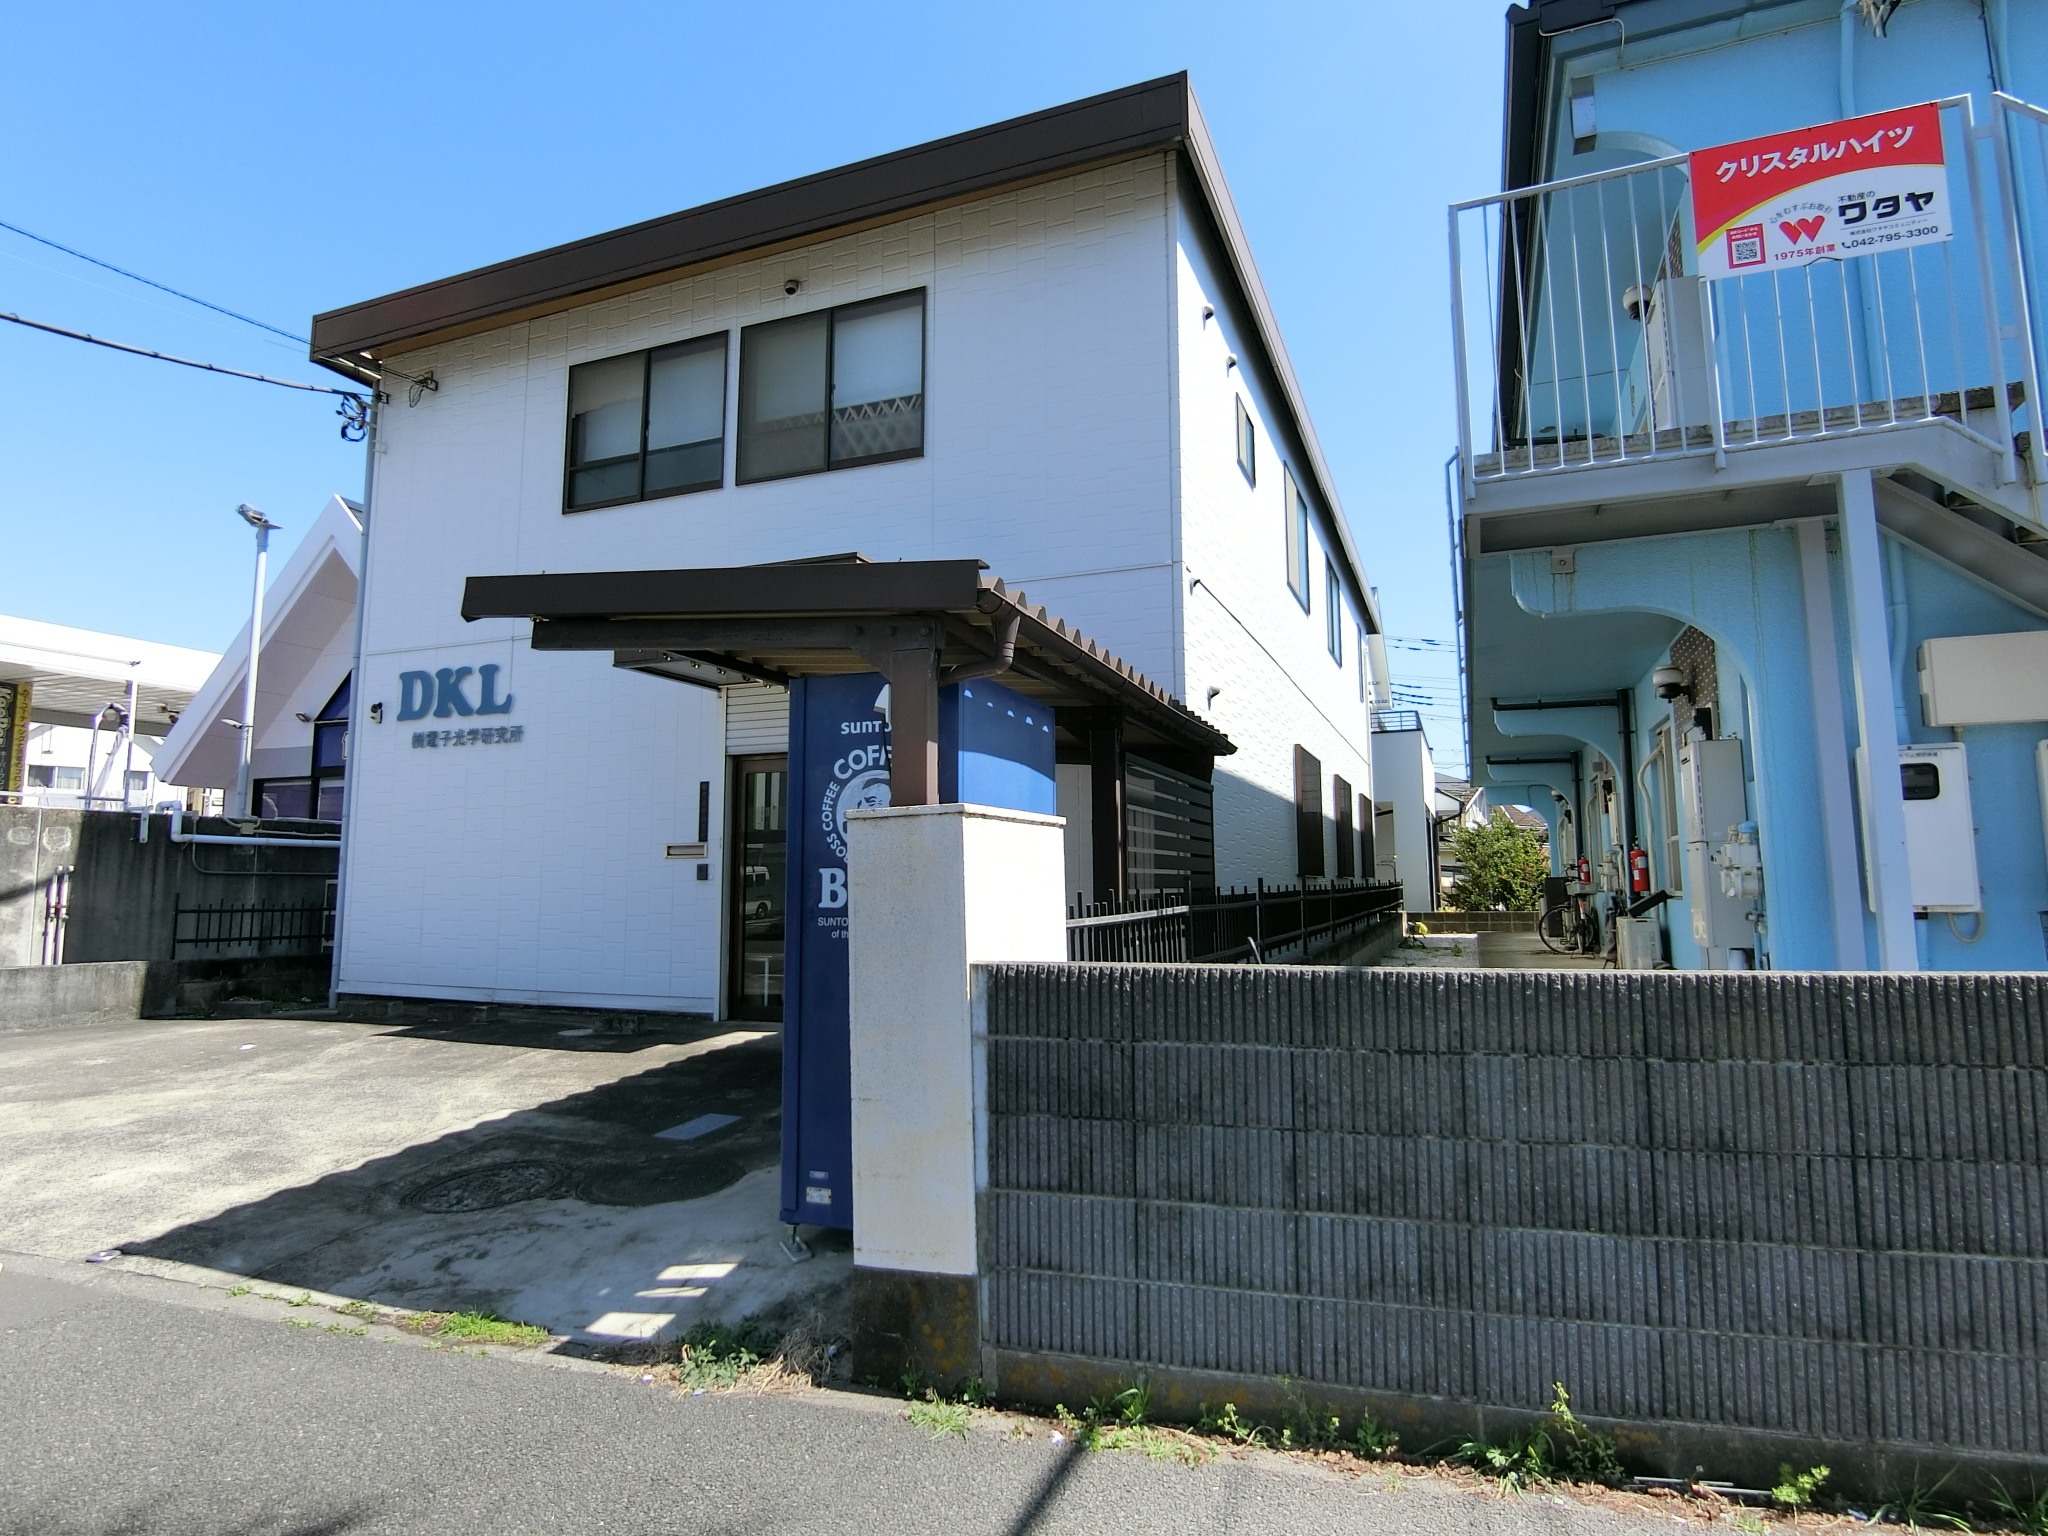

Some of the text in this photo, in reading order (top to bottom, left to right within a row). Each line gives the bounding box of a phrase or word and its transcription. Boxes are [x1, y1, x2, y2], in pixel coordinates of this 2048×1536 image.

[1715, 124, 1914, 183] クリスタルハイツ
[1837, 190, 1876, 204] 不動産の
[1838, 191, 1935, 225] ワタヤ
[1769, 202, 1833, 224] 心をむすぶお取引
[1851, 225, 1939, 248] 042-795-3300
[1773, 243, 1836, 261] 1975年創業
[396, 663, 513, 722] DKL
[821, 781, 841, 831] COFFEE
[818, 867, 848, 909] B
[817, 917, 849, 927] SUNTO
[831, 929, 850, 939] of th
